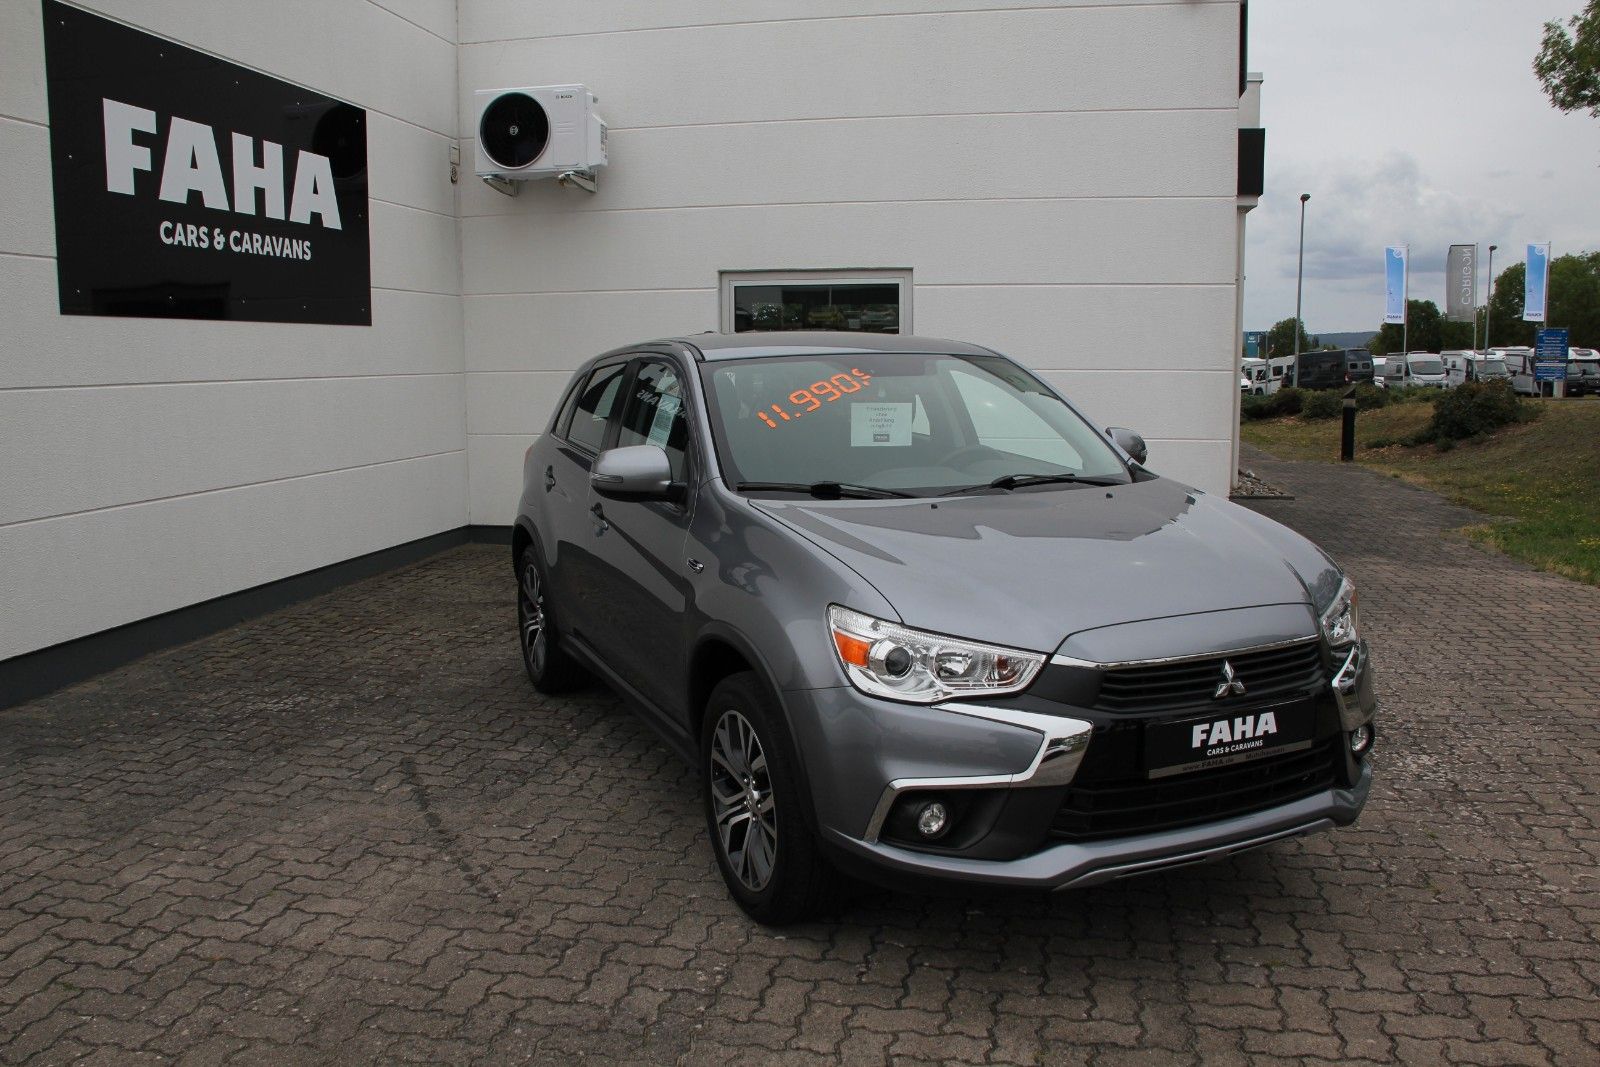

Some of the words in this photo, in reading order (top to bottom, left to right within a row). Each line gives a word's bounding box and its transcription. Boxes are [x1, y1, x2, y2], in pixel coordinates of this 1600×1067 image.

[102, 97, 342, 230] FAHA
[159, 220, 208, 249] CARS
[213, 228, 226, 251] &
[229, 230, 312, 261] CARAVANS
[1192, 711, 1277, 748] FAHA
[1206, 747, 1224, 756] CARS
[1230, 739, 1263, 752] CARAVANS
